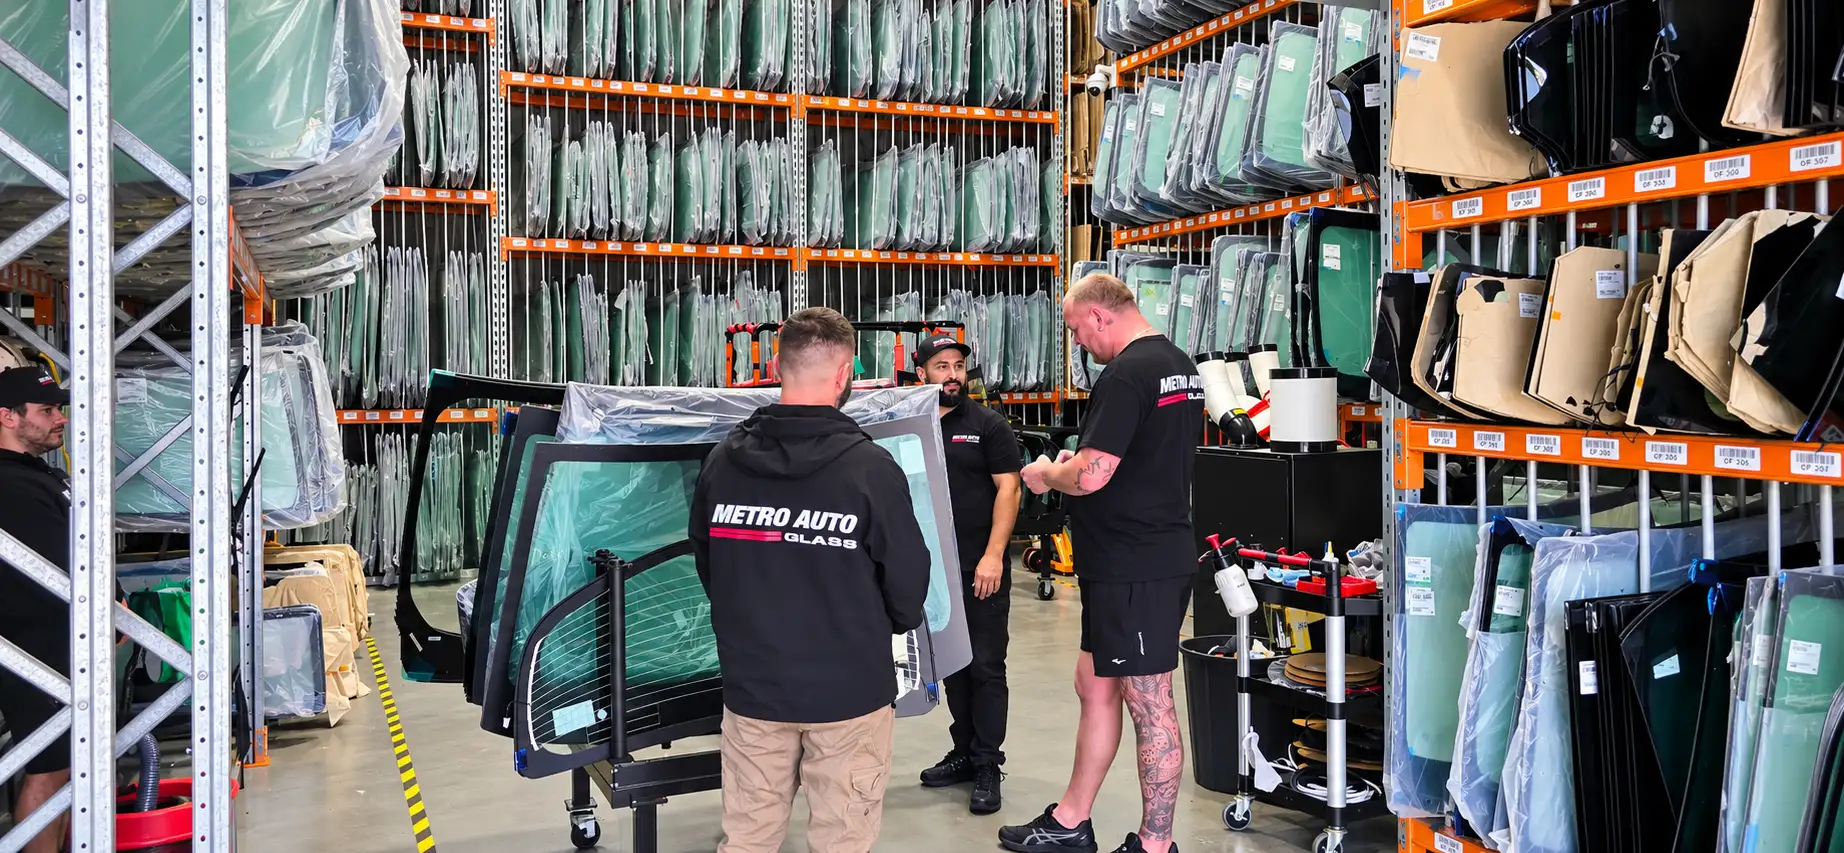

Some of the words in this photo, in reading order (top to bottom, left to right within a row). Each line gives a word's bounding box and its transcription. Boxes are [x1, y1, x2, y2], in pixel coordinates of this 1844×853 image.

[1160, 374, 1188, 395] METRO
[711, 503, 792, 527] METRO
[792, 509, 858, 534] AUTO
[783, 532, 858, 550] GLASS
